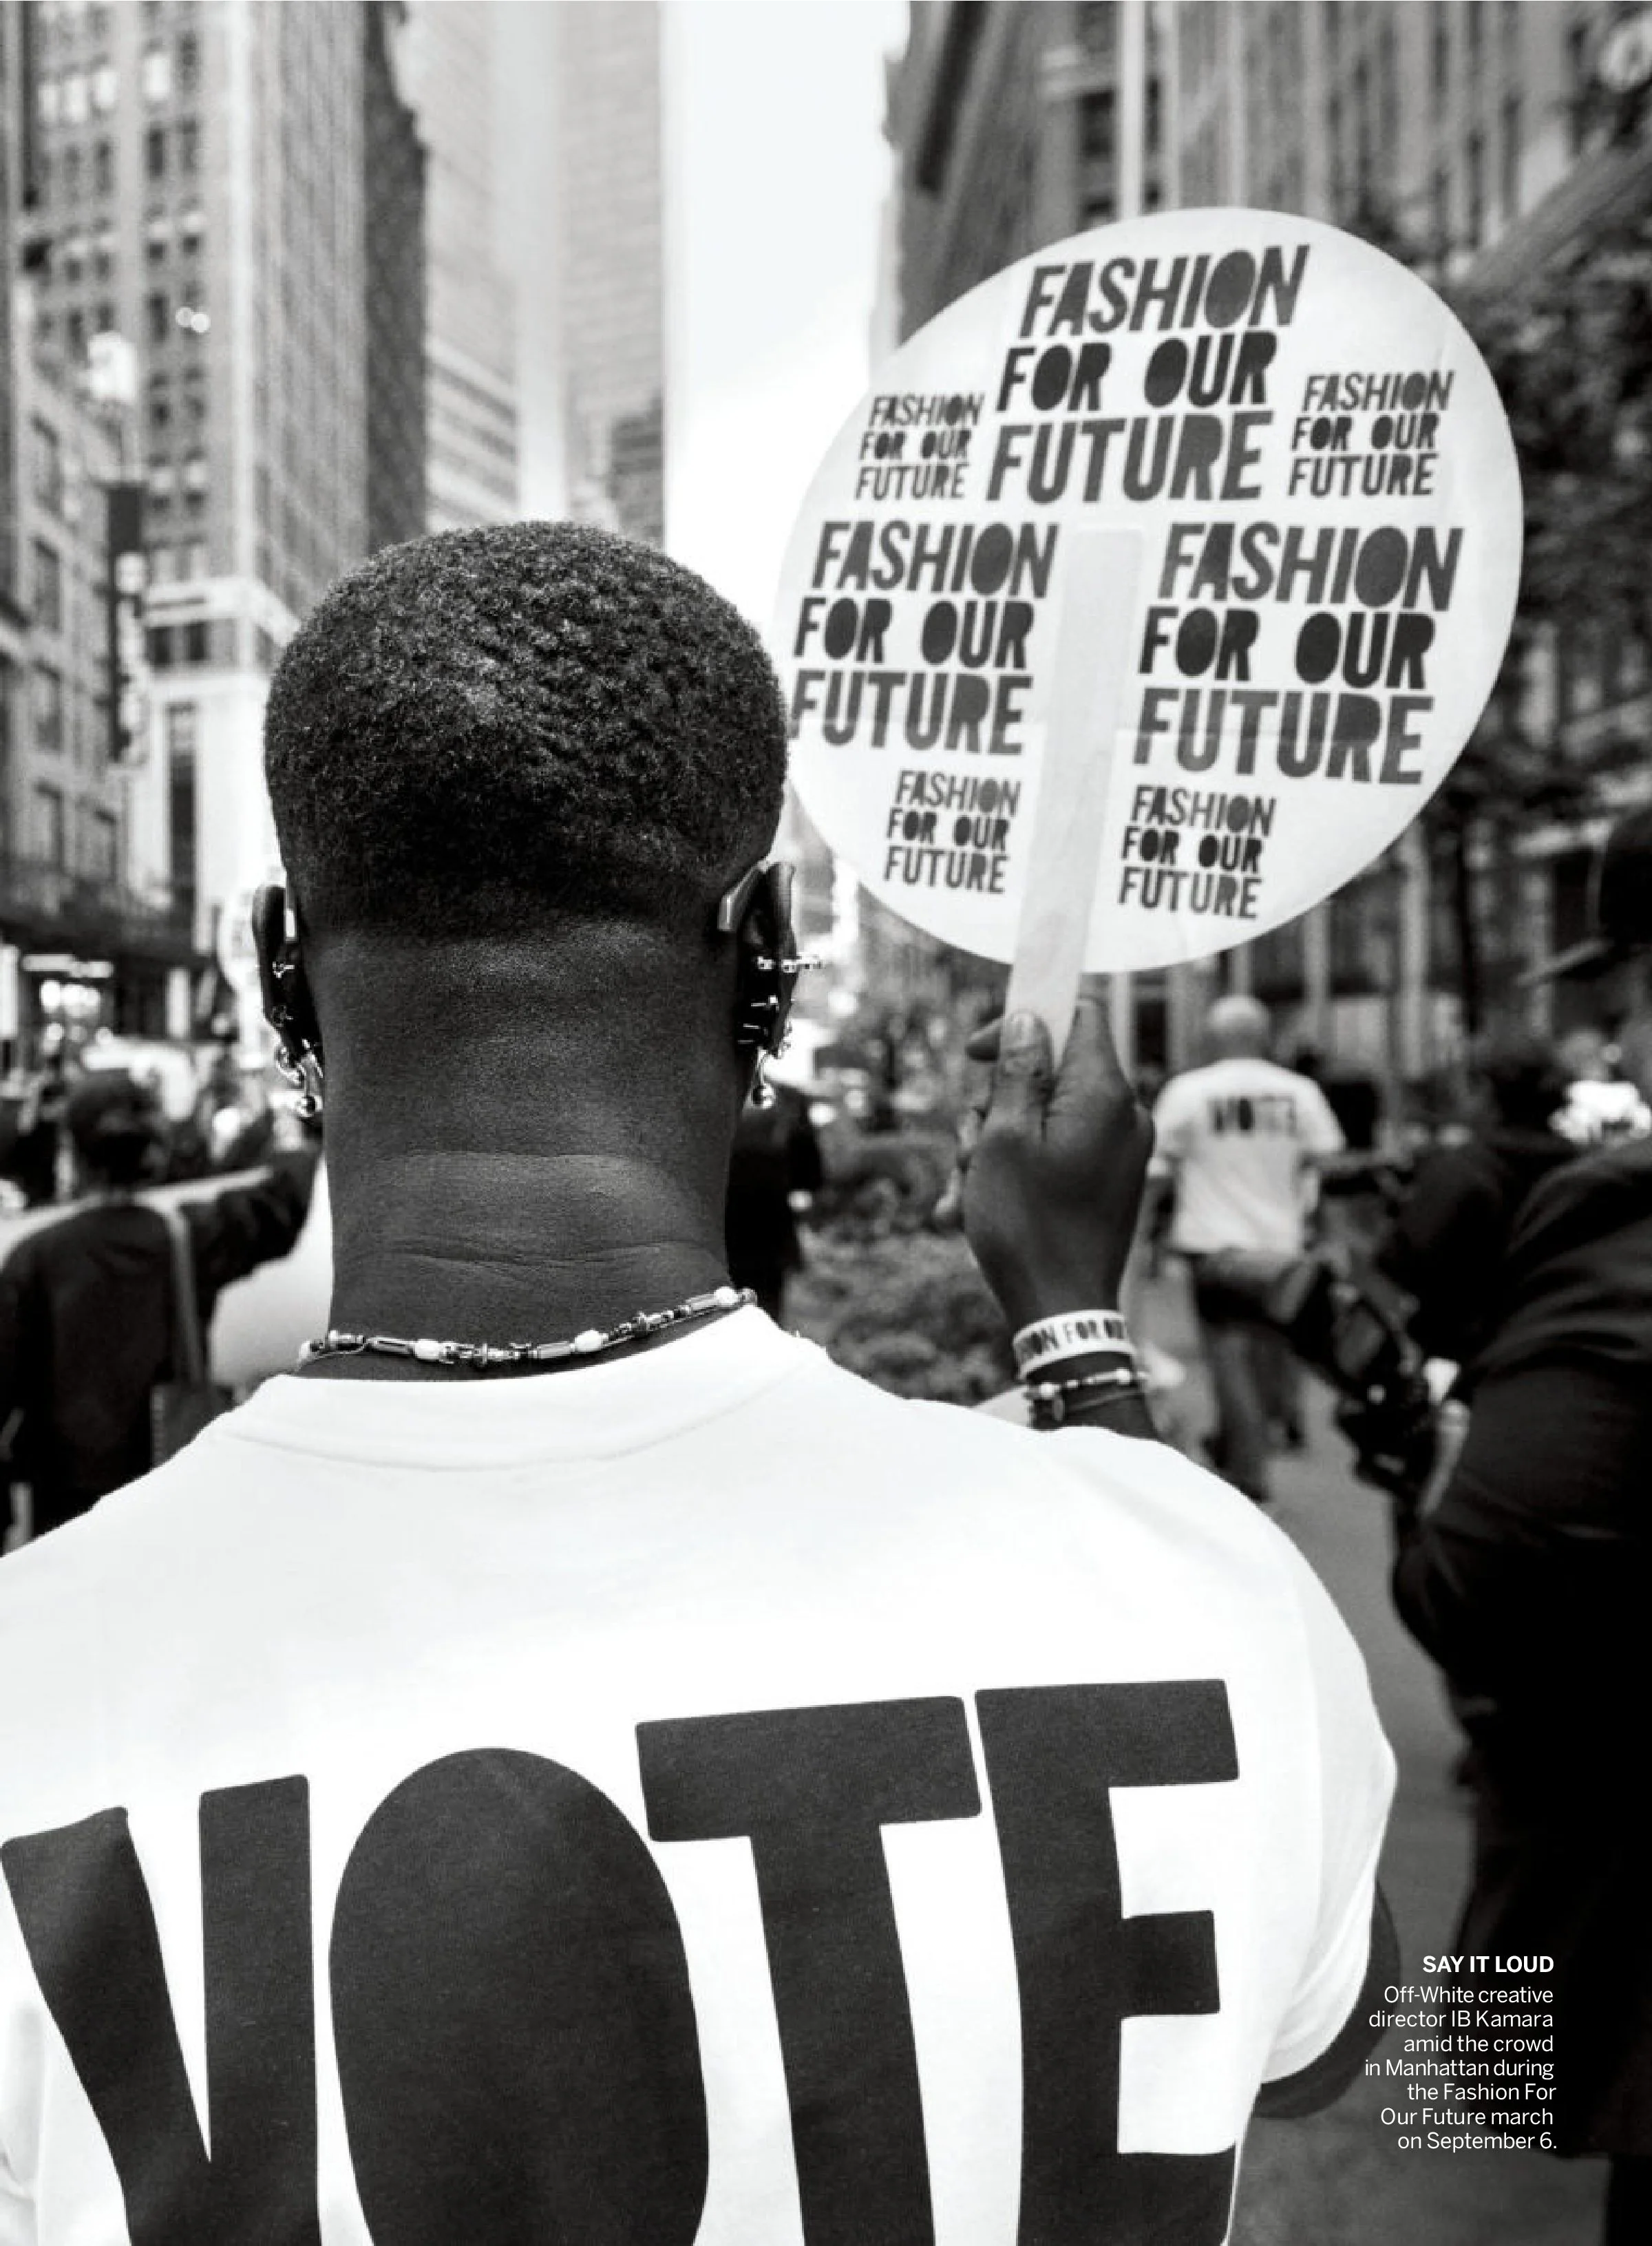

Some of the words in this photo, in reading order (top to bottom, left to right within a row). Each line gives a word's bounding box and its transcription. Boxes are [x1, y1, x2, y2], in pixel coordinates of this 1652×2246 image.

[1019, 244, 1311, 339] FASHION
[996, 342, 1112, 412] FOR
[1143, 330, 1278, 409] OUR
[1302, 370, 1454, 412] FASHION
[869, 393, 983, 430] FASHION
[1291, 415, 1353, 452] FOR
[1370, 412, 1439, 452] OUR
[860, 430, 907, 462] FOR
[920, 427, 972, 460] OUR
[986, 411, 1273, 505] FUTURE
[856, 463, 970, 501] FUTURE
[1288, 453, 1439, 498] FUTURE
[812, 520, 1059, 599] FASHION
[1158, 521, 1464, 612] FASHION
[794, 597, 893, 664] FOR
[920, 600, 1035, 671] OUR
[1138, 606, 1260, 682] FOR
[1294, 611, 1436, 690] OUR
[786, 669, 1034, 755] FUTURE
[1134, 687, 1434, 785] FUTURE
[896, 770, 1021, 817] FASHION
[1131, 784, 1276, 837] FASHION
[887, 808, 938, 845] FOR
[953, 814, 1010, 853] OUR
[1121, 825, 1180, 867] FOR
[1198, 831, 1263, 875] OUR
[884, 845, 1008, 894] FUTURE
[1119, 866, 1262, 919] FUTURE
[0, 1680, 1238, 2246] VOTE
